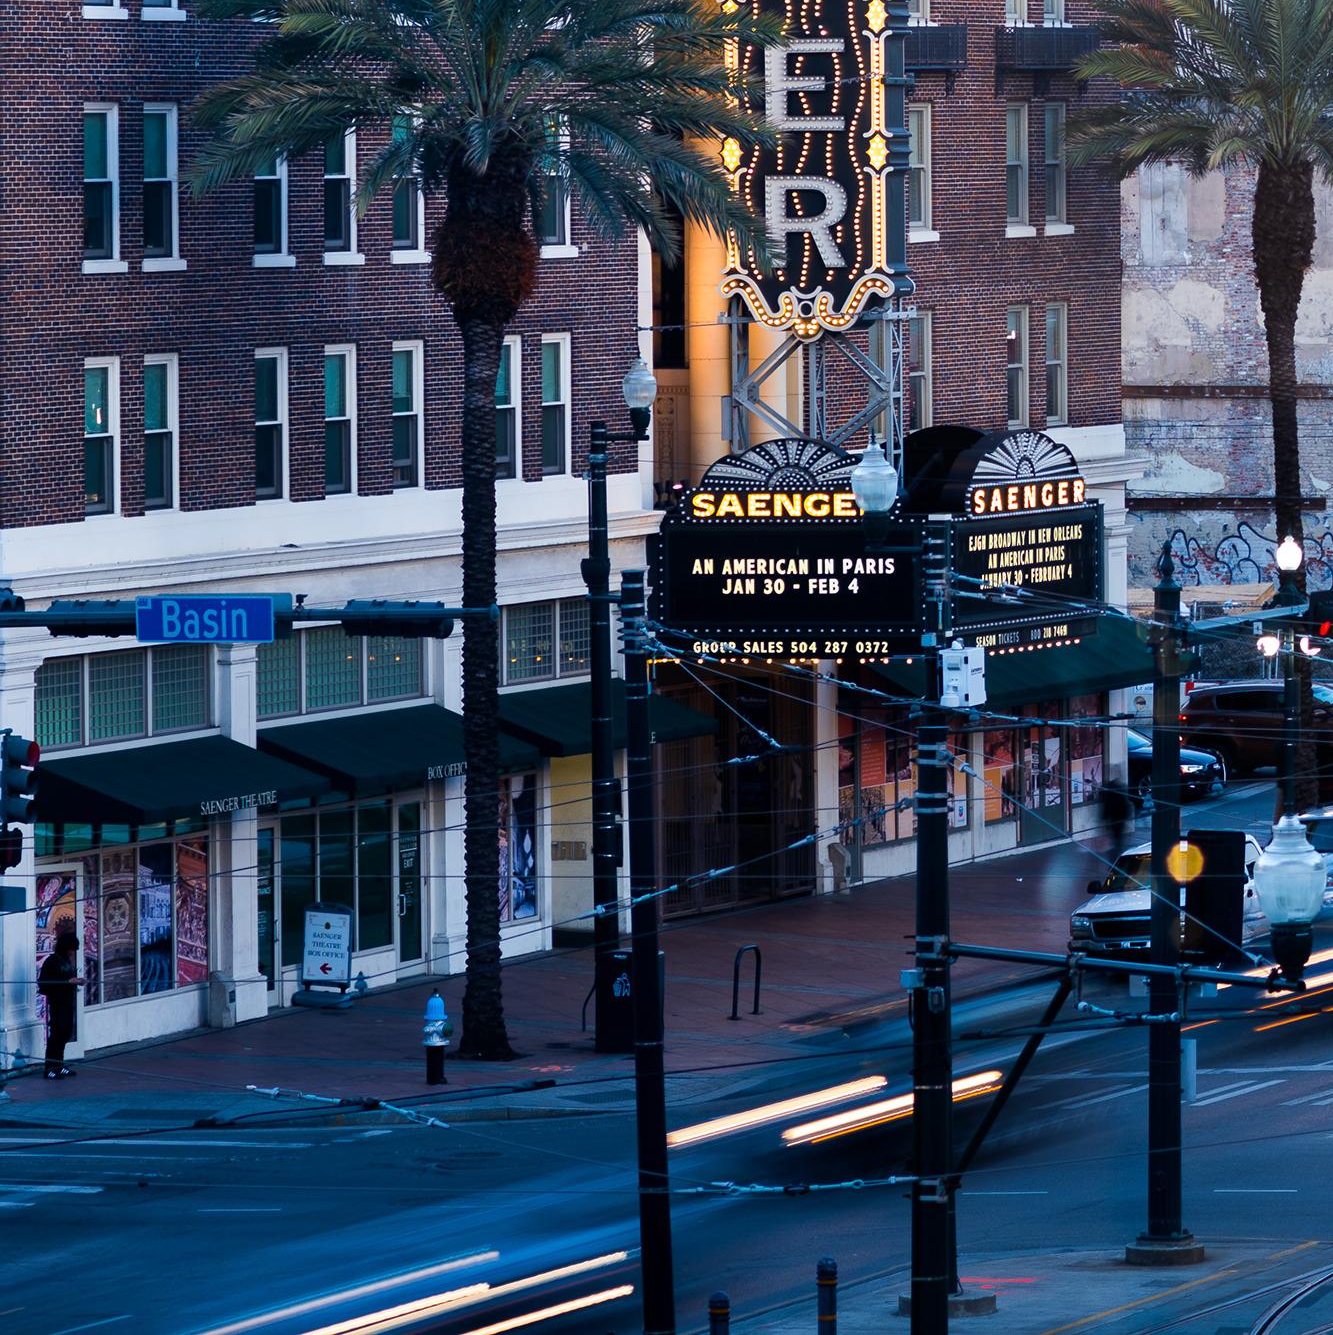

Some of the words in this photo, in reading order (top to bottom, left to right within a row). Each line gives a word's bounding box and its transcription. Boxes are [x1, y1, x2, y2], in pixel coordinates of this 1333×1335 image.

[691, 493, 866, 517] SAENGE
[973, 479, 1085, 514] SAENGER
[988, 530, 1026, 549] BROADWAY
[1028, 529, 1036, 545] IN
[1038, 527, 1051, 544] NEW
[1053, 523, 1083, 542] ORLEANS
[988, 553, 998, 569] AN
[999, 548, 1034, 567] AMERICAN
[1036, 548, 1043, 563] IN
[1045, 546, 1065, 562] PARIS
[692, 559, 714, 575] AN
[722, 559, 809, 575] AMERICAN
[817, 558, 835, 574] IN
[842, 558, 896, 574] PARIS
[1014, 570, 1023, 585] 30
[1030, 564, 1066, 583] FEBRUARY
[1067, 563, 1073, 578] 4
[722, 579, 756, 595] JAN
[763, 578, 785, 594] 30
[808, 578, 840, 594] FEB
[848, 578, 859, 594] 4
[161, 600, 248, 638] Basin
[743, 642, 784, 654] SALES
[790, 642, 817, 654] 504
[824, 642, 848, 654] 287
[855, 642, 889, 654] 0372
[976, 634, 996, 648] SEASON
[998, 631, 1020, 645] TICKETS
[427, 764, 443, 780] BOX
[200, 795, 239, 816] SAENGER
[240, 790, 278, 810] THEATRE
[311, 941, 342, 949] THEATRE
[312, 933, 342, 941] SAENGER
[322, 951, 345, 959] OFFICE
